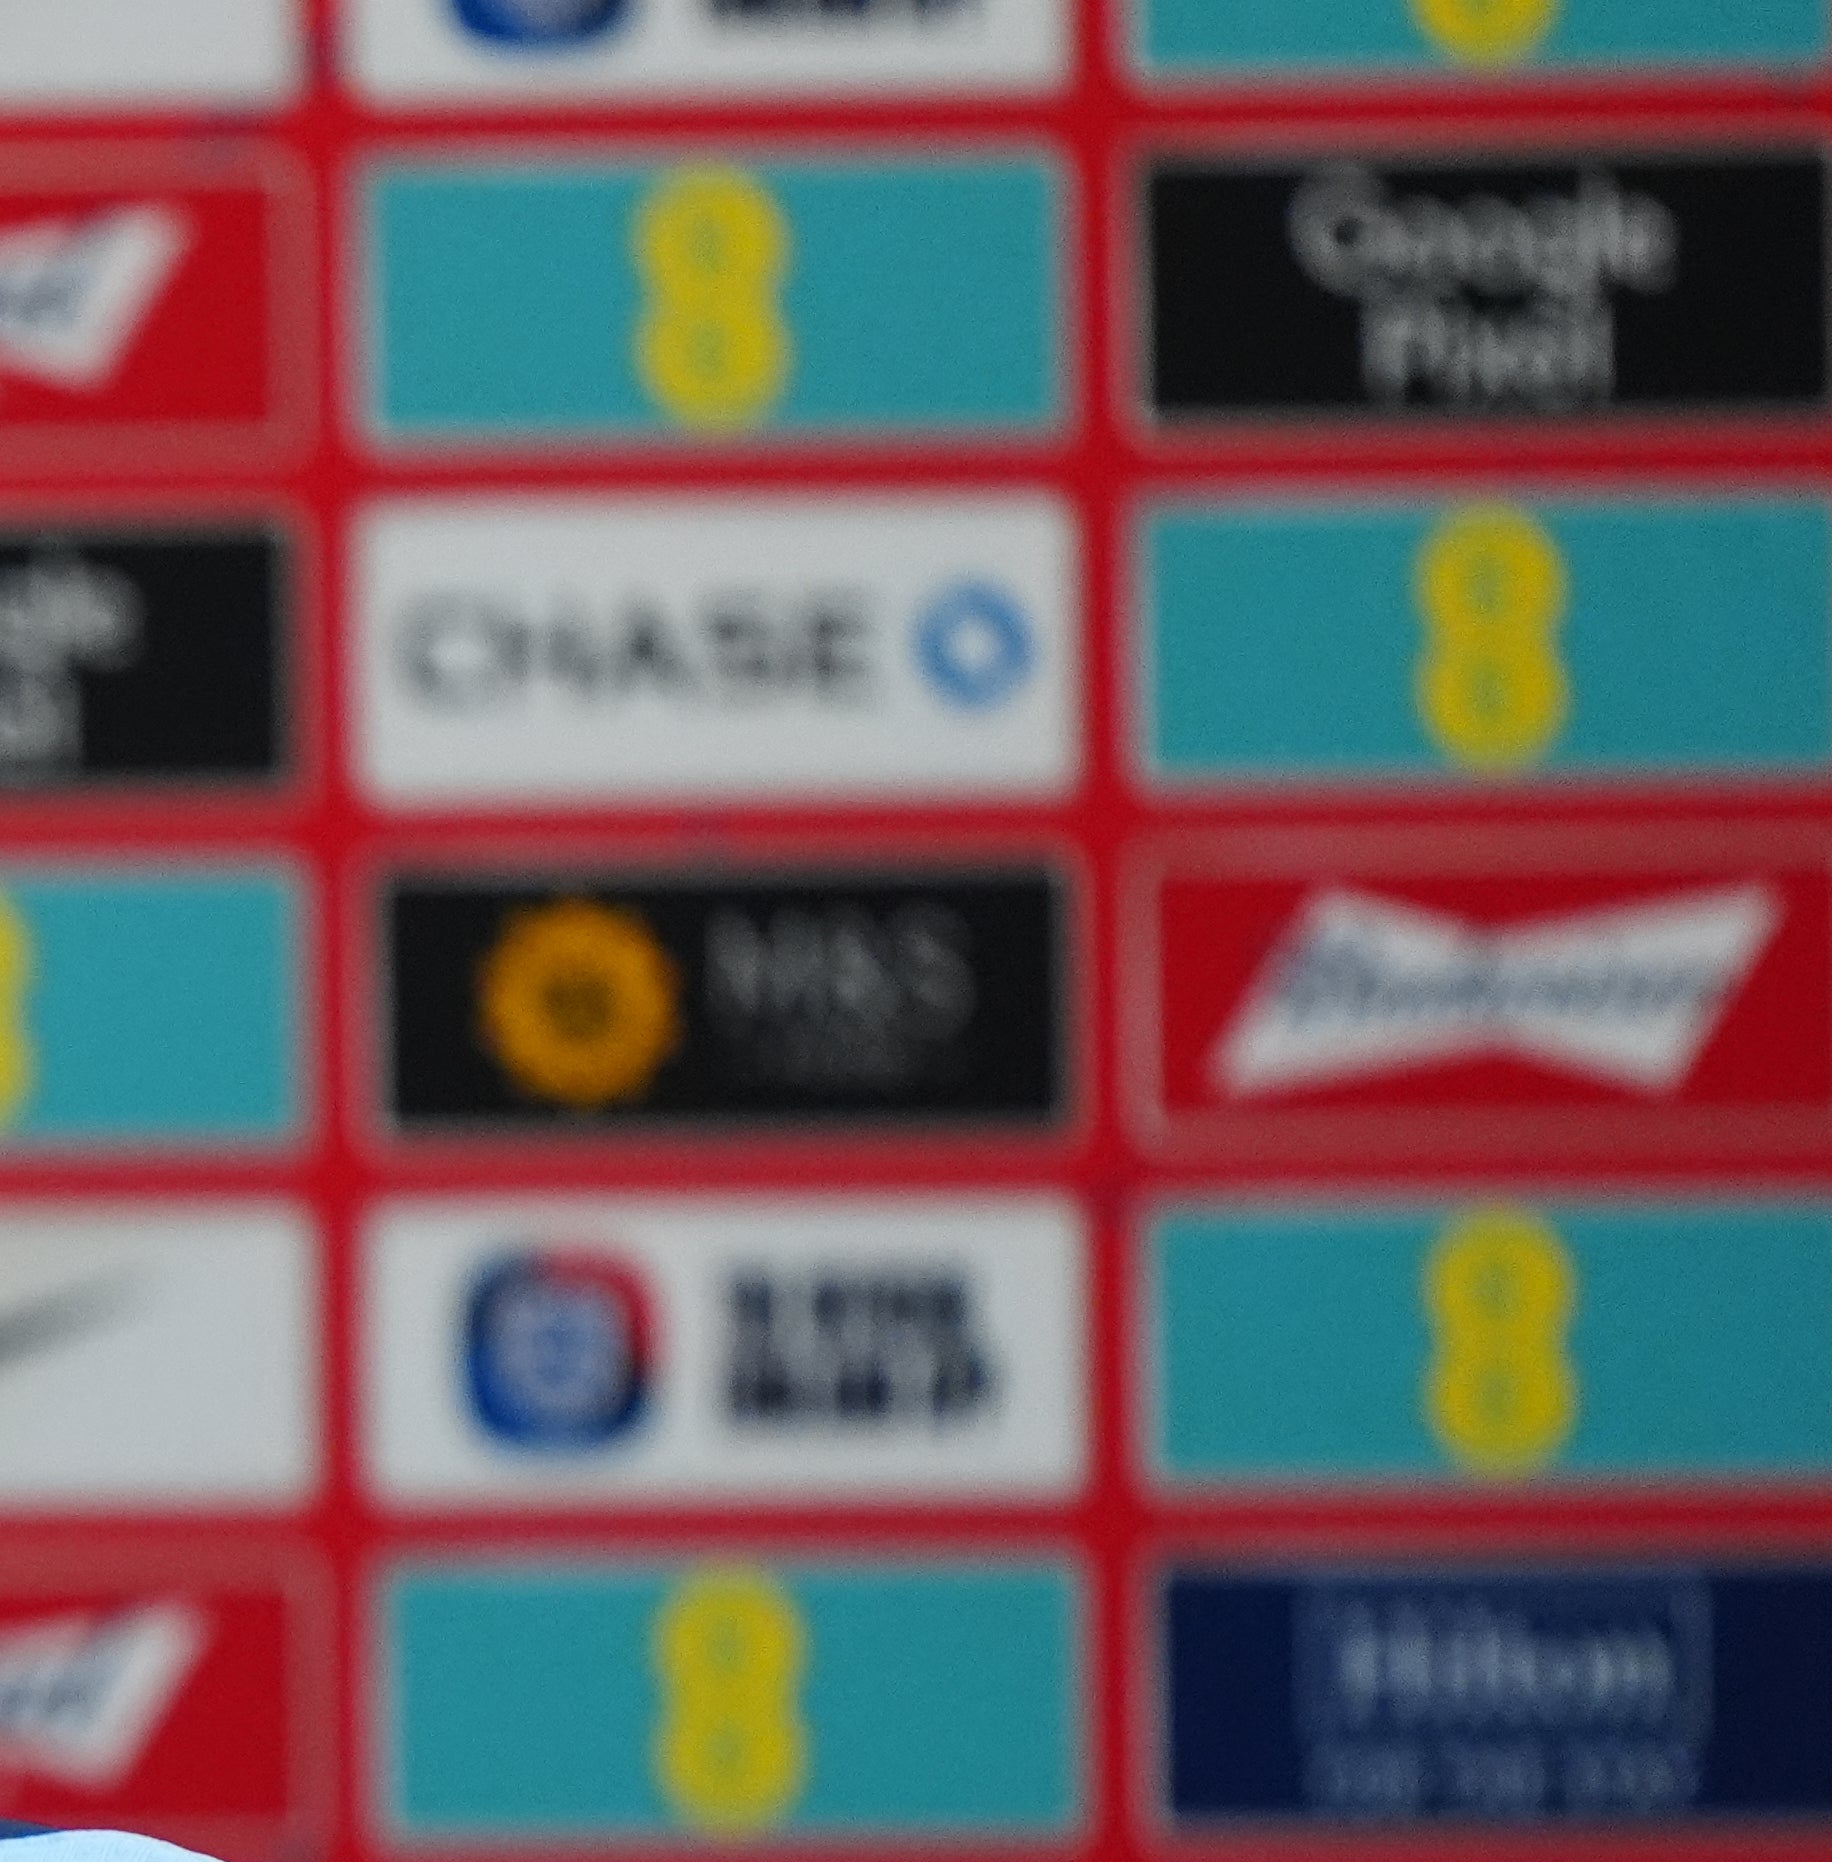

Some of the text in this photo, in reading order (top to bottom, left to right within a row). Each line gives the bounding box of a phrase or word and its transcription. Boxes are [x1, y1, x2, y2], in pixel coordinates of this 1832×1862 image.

[1291, 168, 1673, 308] Google
[1362, 266, 1616, 396] Pixel
[396, 590, 874, 704] CHASE
[1339, 1578, 1674, 1708] Hilton
